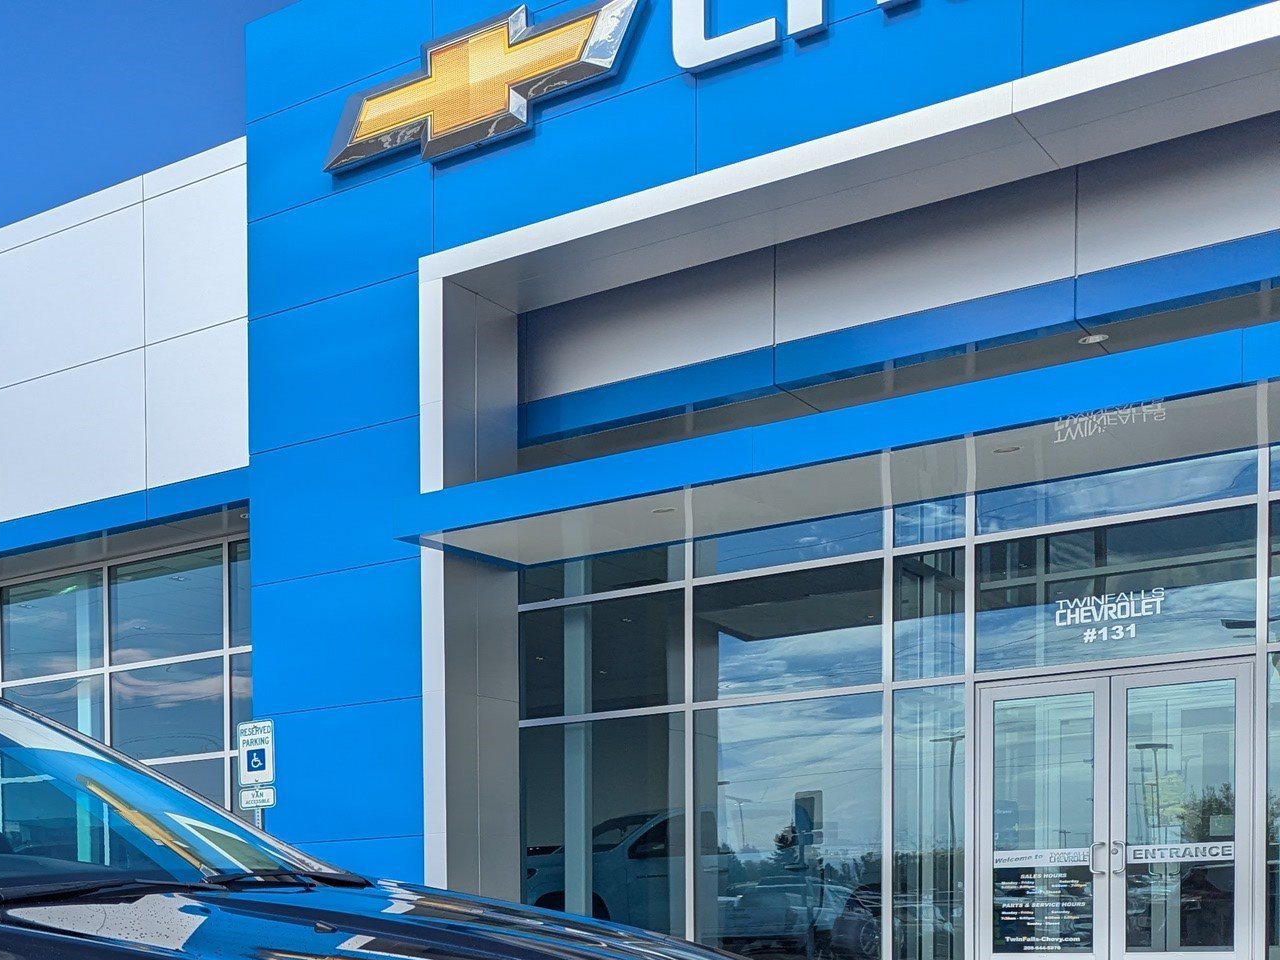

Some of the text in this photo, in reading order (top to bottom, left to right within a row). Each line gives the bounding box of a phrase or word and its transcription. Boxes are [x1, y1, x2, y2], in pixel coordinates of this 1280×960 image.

[1055, 597, 1165, 627] CHEVROLET
[1083, 623, 1136, 644] #131
[240, 725, 271, 737] RESERVED
[242, 736, 270, 748] PARKING
[251, 791, 264, 799] VAN
[1133, 845, 1233, 860] ENTRANCE
[995, 855, 1033, 864] Welcome
[1049, 855, 1089, 863] CHEVROLE
